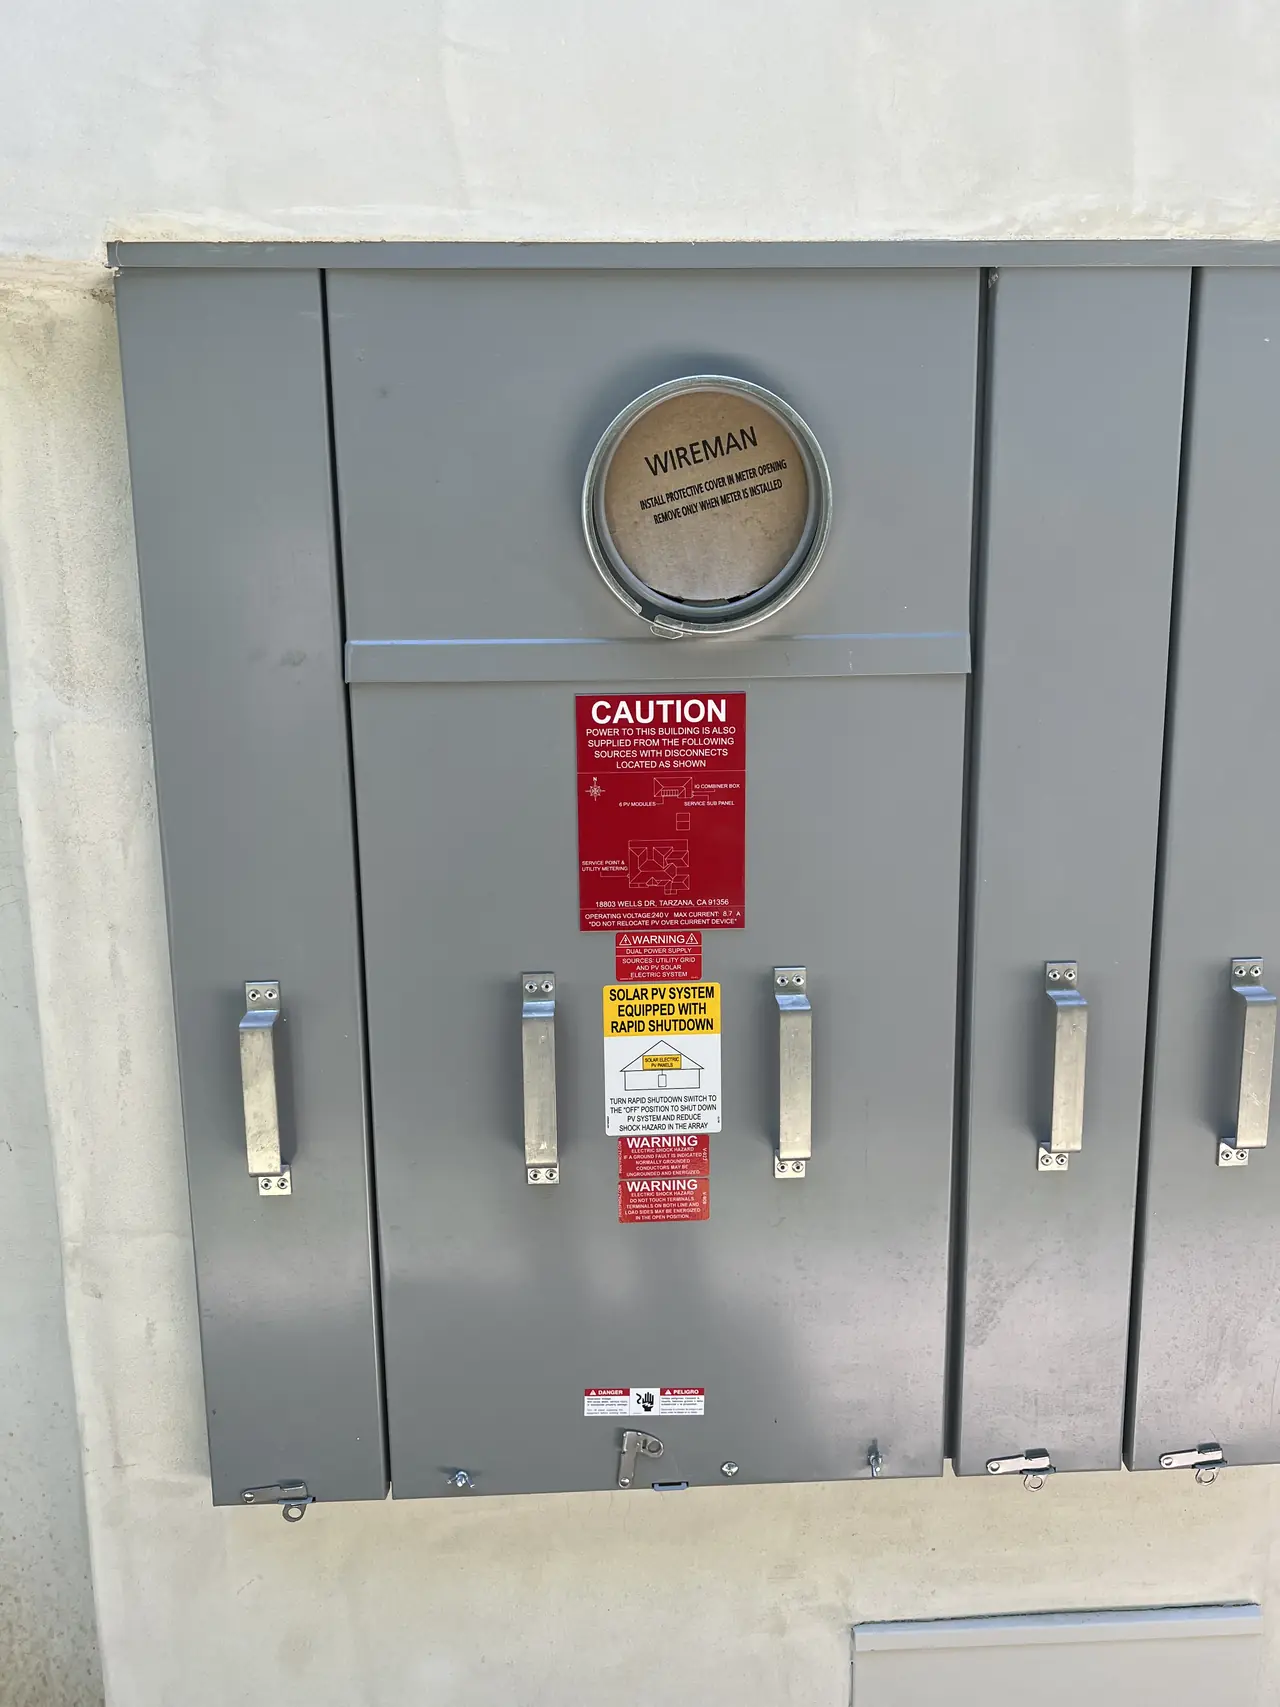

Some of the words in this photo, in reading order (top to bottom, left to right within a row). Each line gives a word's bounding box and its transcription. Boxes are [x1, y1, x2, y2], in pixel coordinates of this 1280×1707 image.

[644, 426, 758, 476] WIREMAN
[640, 495, 666, 510] INSTALL
[666, 483, 704, 504] PROTECTIVE
[704, 478, 726, 493] COVER
[727, 475, 735, 485] IN
[735, 467, 758, 483] METER
[758, 459, 787, 476] OPENING
[654, 509, 681, 524] REMOVE
[682, 503, 699, 517] ONLY
[700, 497, 720, 511] WHEN
[721, 492, 742, 506] METER
[743, 490, 749, 499] IS
[749, 478, 783, 497] INSTALLED
[591, 699, 726, 724] CAUTION
[586, 728, 619, 736] POWER
[712, 726, 736, 734] ALSO
[588, 739, 631, 747] SUPPLIED
[682, 738, 734, 746] FOLLOWING
[594, 750, 637, 758] SOURCES
[639, 749, 662, 757] WITH
[665, 748, 728, 757] DISCONNECTS
[632, 935, 685, 944] WARNING
[609, 988, 648, 1001] SOLAR
[652, 987, 666, 1000] PV
[669, 986, 714, 1000] SYSTEM
[618, 1003, 675, 1017] EQUIPPED
[678, 1003, 706, 1015] WITH
[611, 1020, 645, 1033] RAPID
[649, 1018, 713, 1032] SHUTDOWN
[627, 1136, 698, 1148] WARNING
[627, 1179, 698, 1192] WARNING
